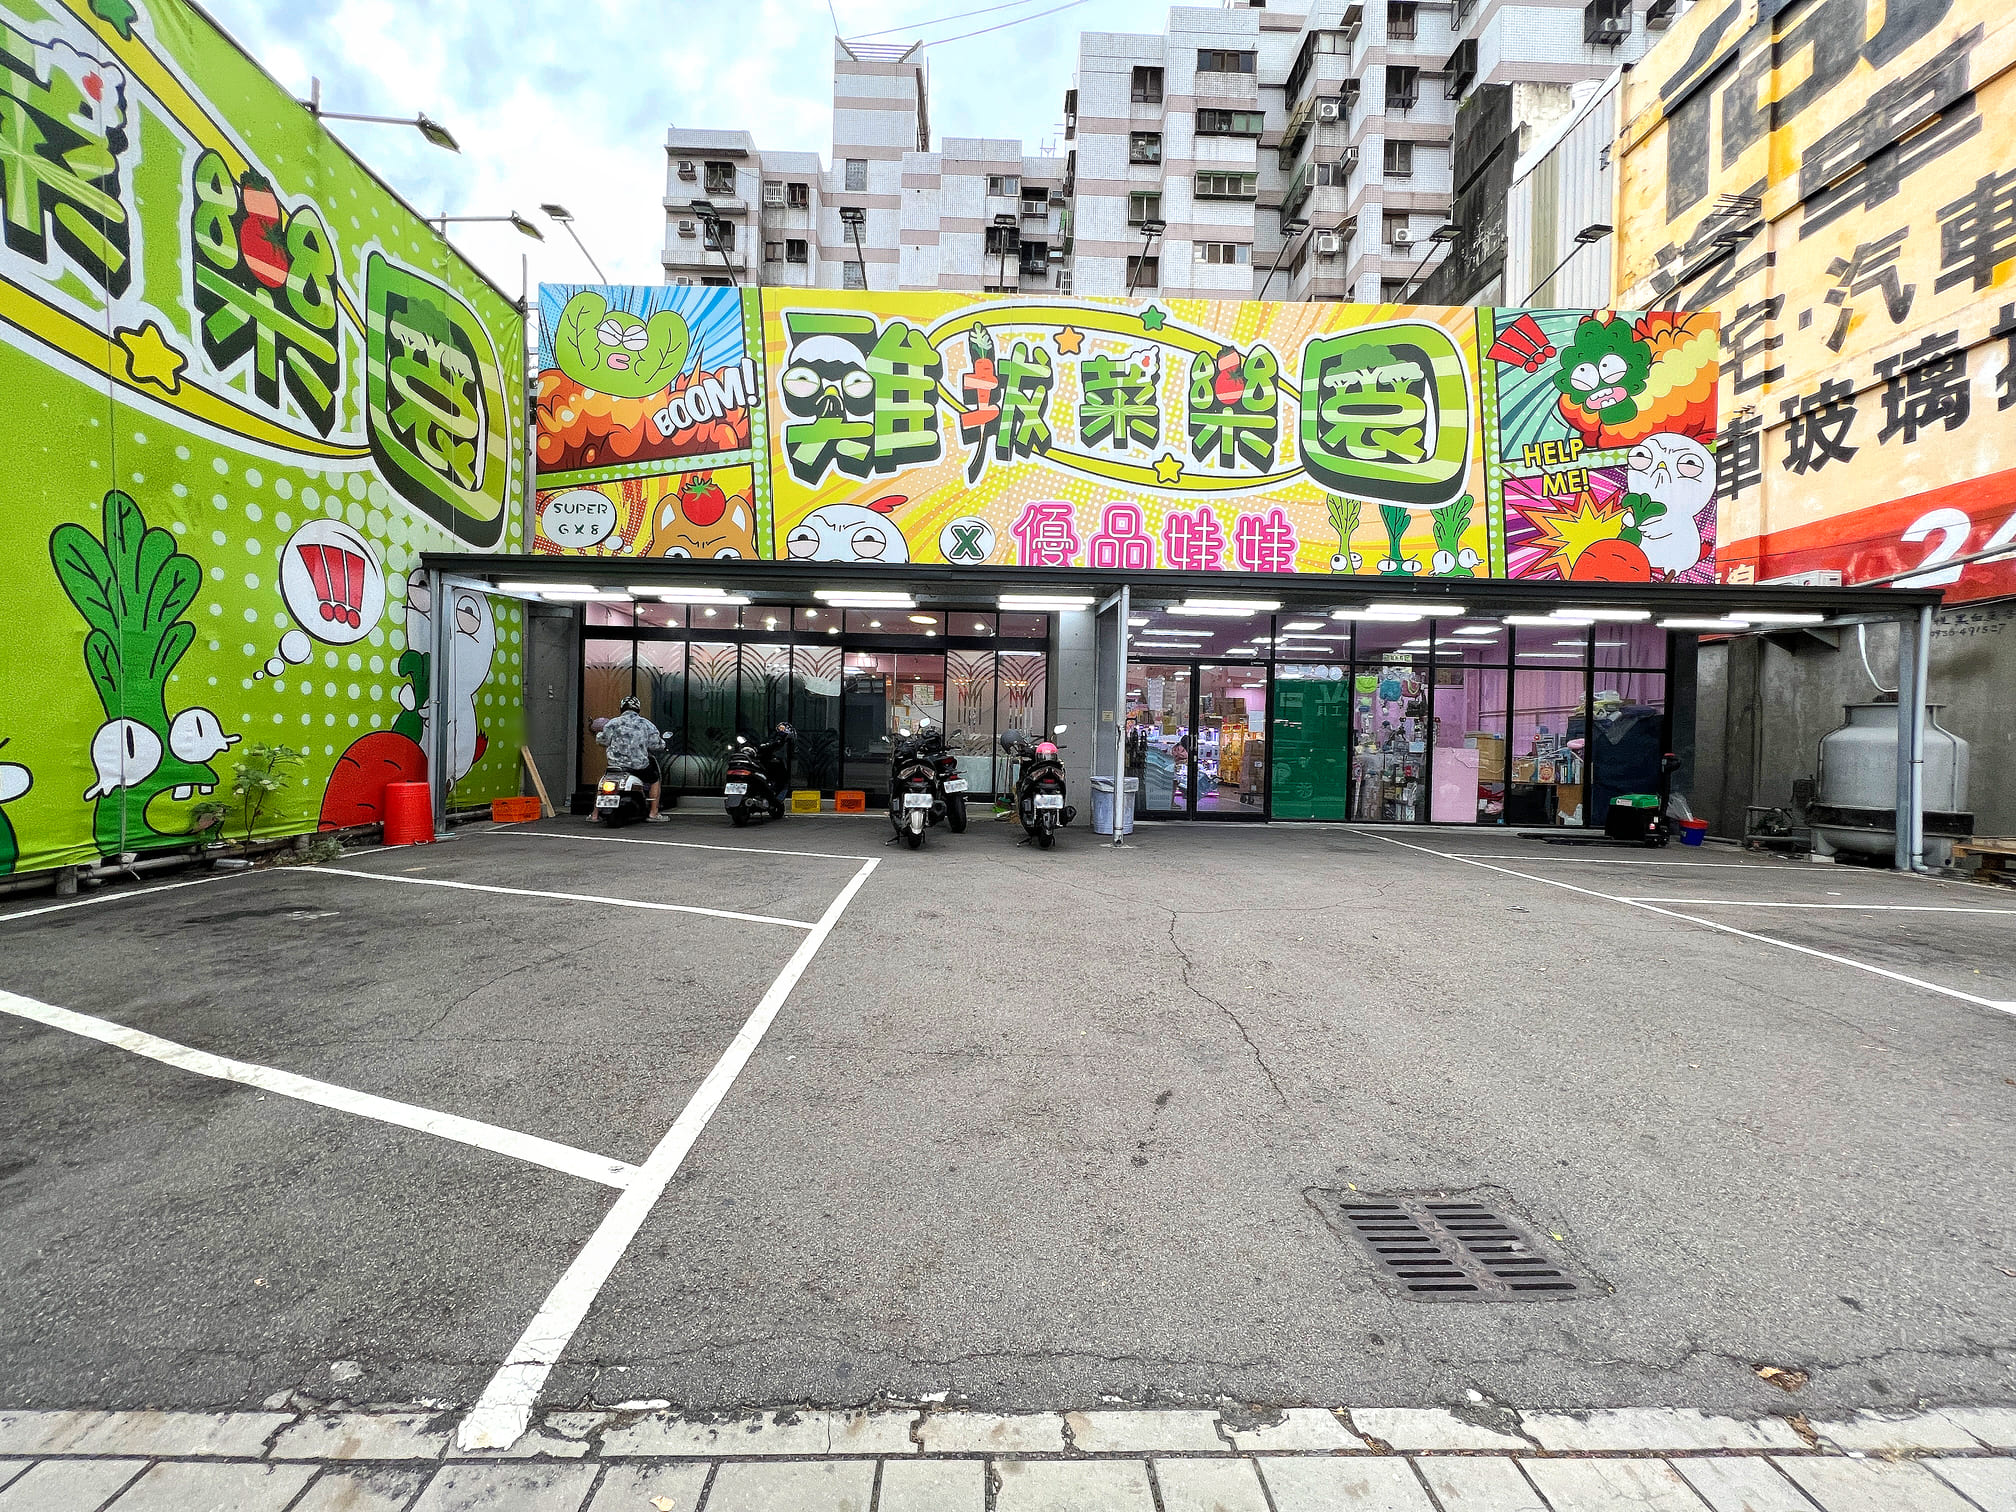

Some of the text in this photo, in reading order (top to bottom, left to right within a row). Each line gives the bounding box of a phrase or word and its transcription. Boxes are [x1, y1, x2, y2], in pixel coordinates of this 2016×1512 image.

[651, 357, 761, 438] BOOM!
[1522, 437, 1584, 468] HELP
[1542, 469, 1590, 497] ME!
[553, 503, 608, 514] SUPER
[1010, 502, 1300, 573] 優品娃娃
